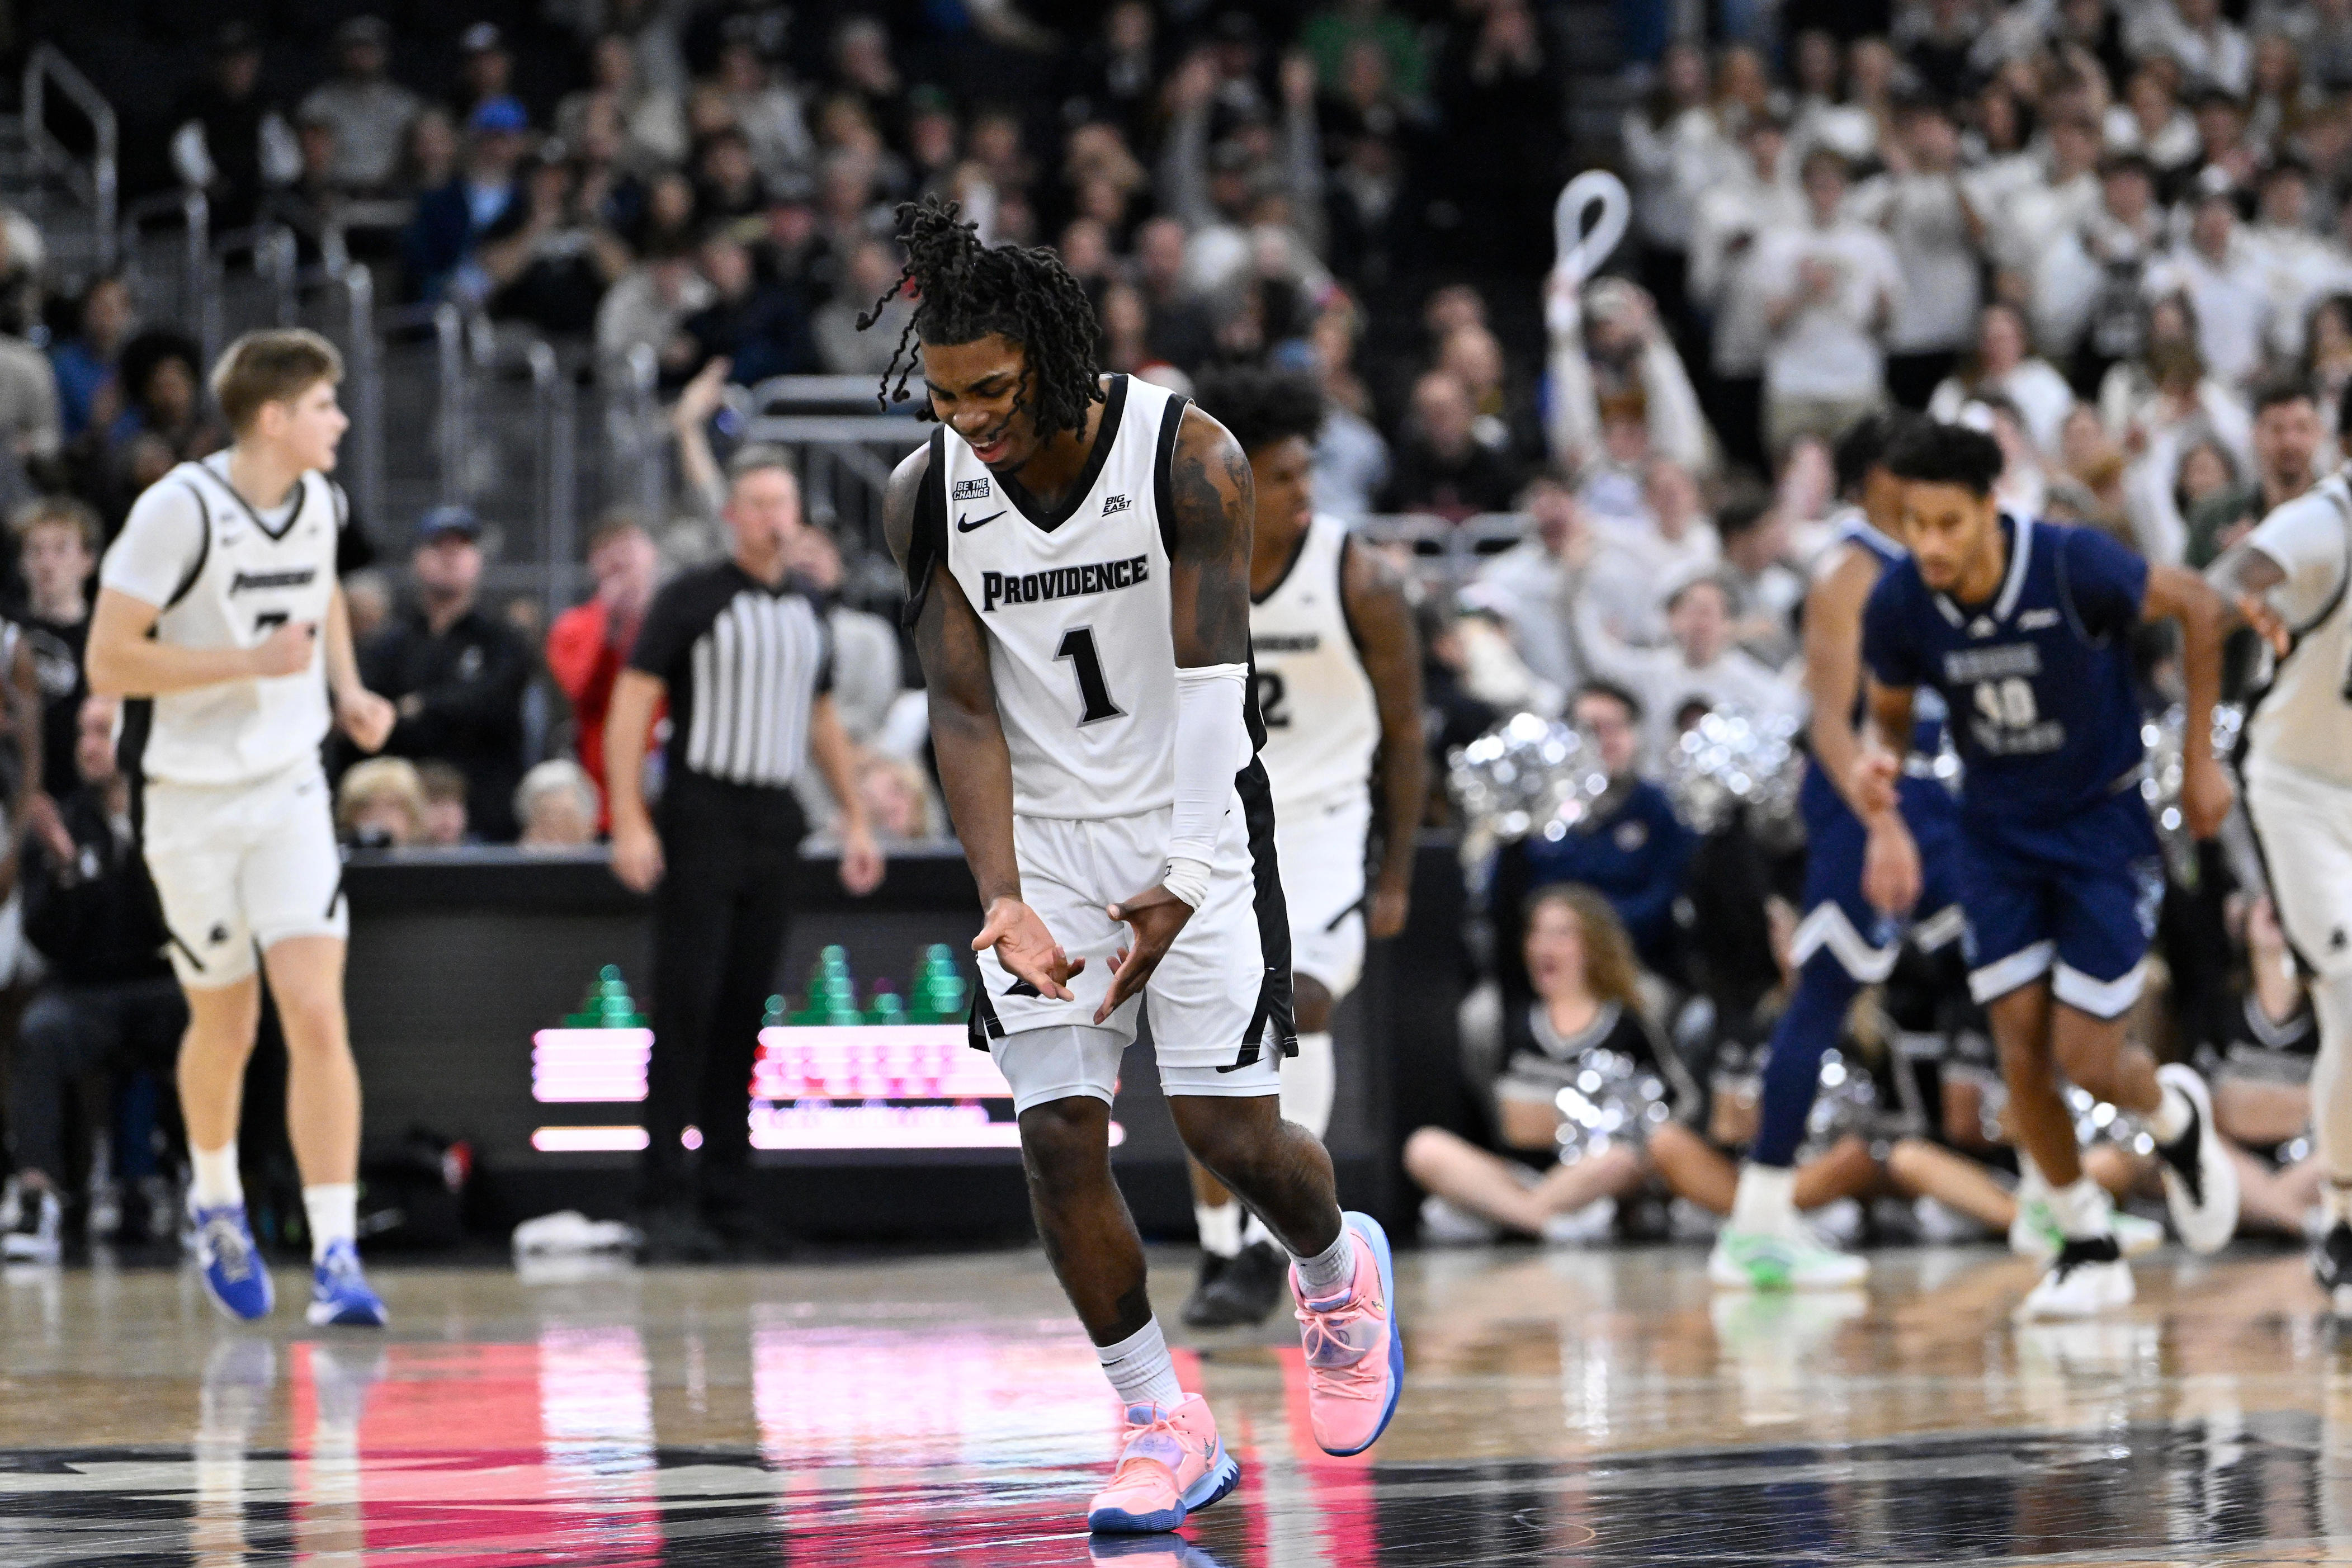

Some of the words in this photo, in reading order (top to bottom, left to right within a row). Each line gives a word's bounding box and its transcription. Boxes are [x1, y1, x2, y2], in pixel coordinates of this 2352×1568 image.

[957, 481, 970, 491] BE
[972, 478, 987, 489] THE
[953, 488, 989, 500] CHANGE
[1104, 494, 1125, 505] BIG
[1103, 500, 1132, 513] EAST
[981, 553, 1150, 613] PROVIDENCE
[1052, 625, 1128, 728] 1
